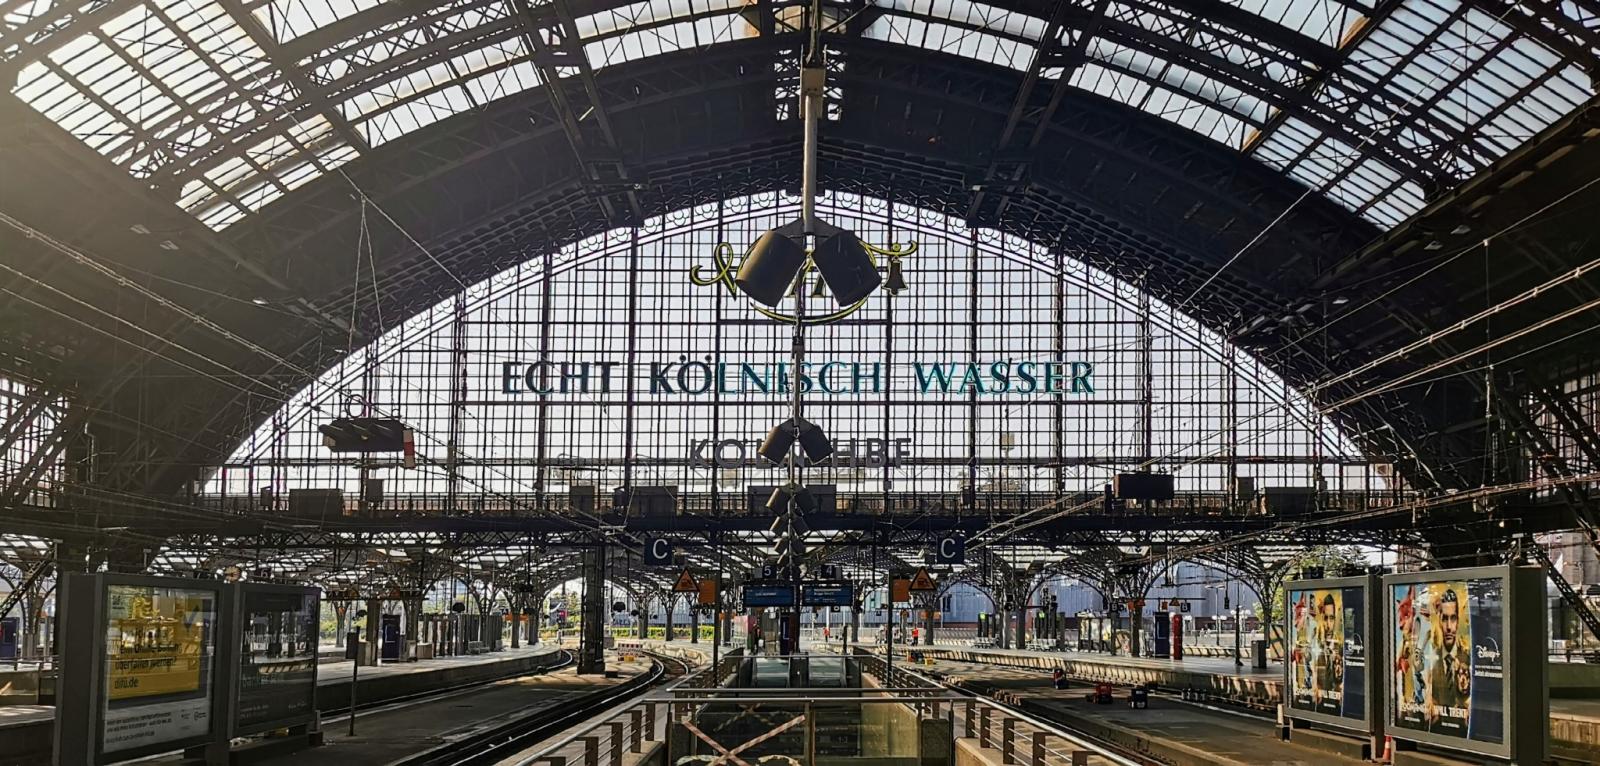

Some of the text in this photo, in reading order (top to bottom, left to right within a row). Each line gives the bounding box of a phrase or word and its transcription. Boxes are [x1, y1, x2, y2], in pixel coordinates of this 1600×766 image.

[502, 354, 1096, 395] ECHT KÖLNISCH WASSER
[832, 437, 912, 469] HBF
[652, 538, 668, 559] C
[940, 537, 956, 559] C
[764, 565, 772, 576] 5
[825, 566, 833, 576] 4
[1475, 643, 1501, 662] Disney+
